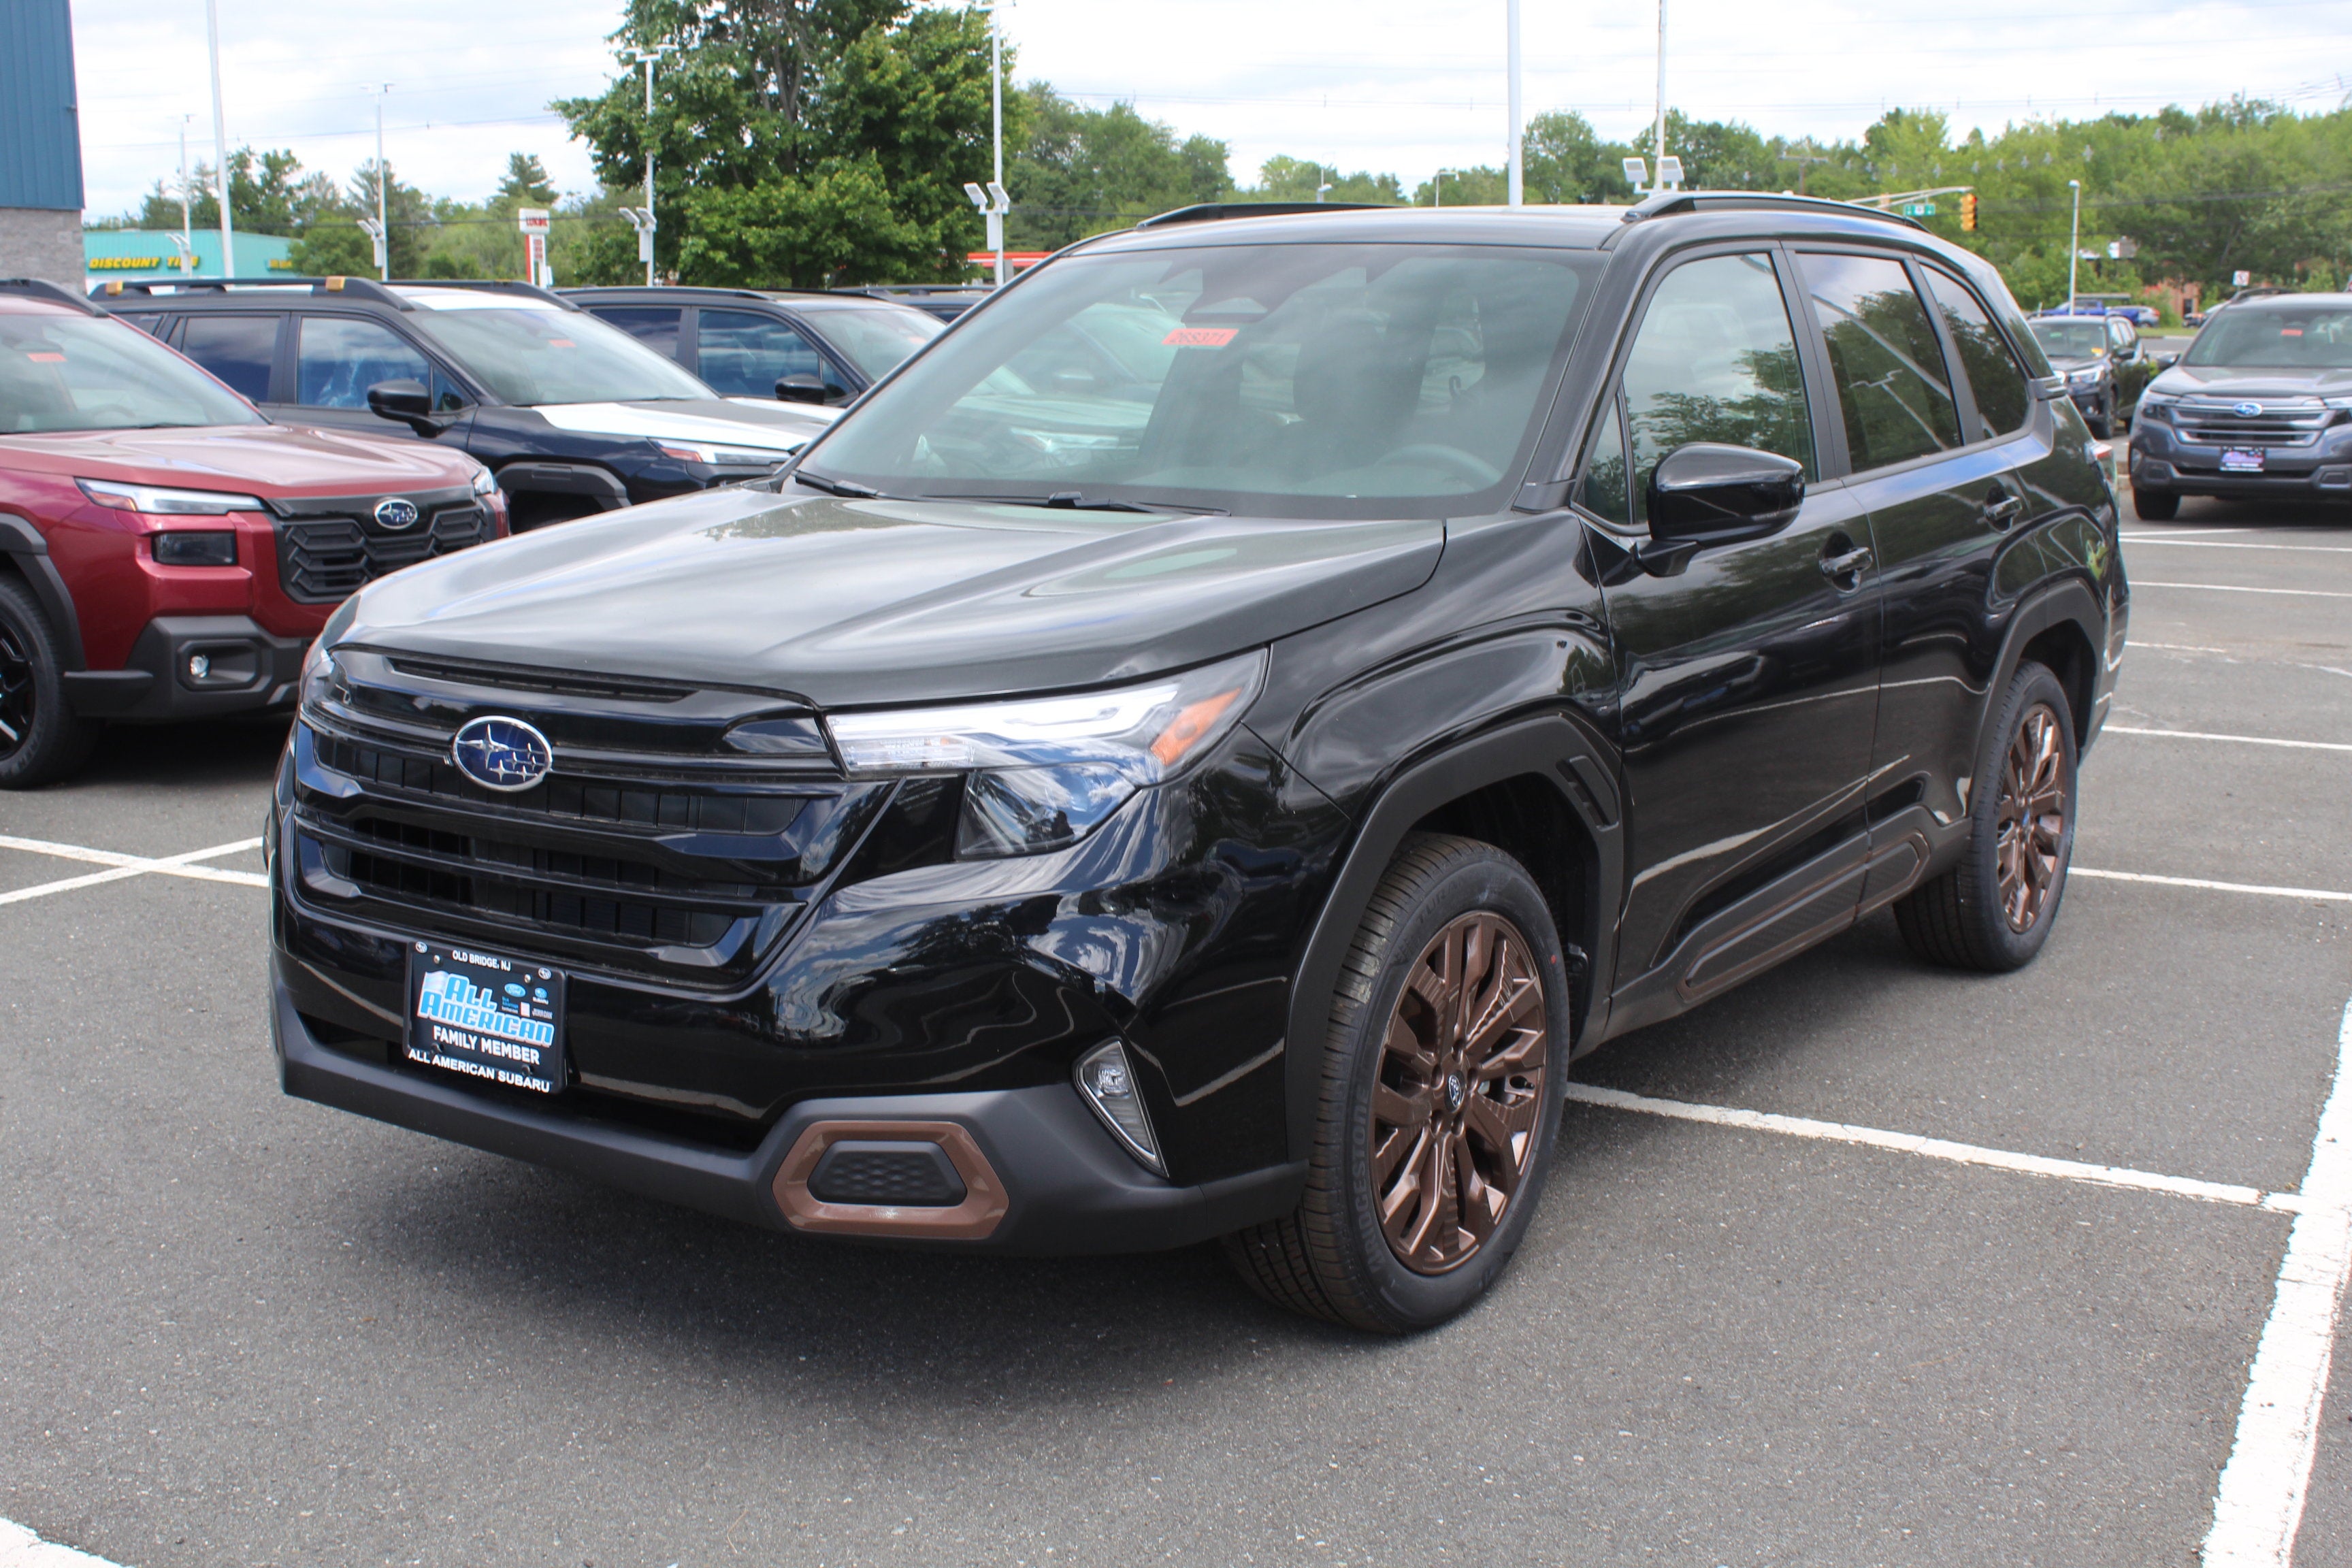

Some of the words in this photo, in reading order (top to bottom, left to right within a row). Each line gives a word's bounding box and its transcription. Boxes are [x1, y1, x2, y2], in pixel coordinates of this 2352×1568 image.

[88, 257, 160, 270] DISCOUNT
[452, 949, 468, 962] OLD
[501, 960, 511, 971] NJ
[433, 1025, 478, 1050] FAMILY
[480, 1037, 540, 1065] MEMBER
[408, 1048, 430, 1064] ALL
[432, 1054, 495, 1079] AMERICAN
[497, 1070, 551, 1093] SUBARU
